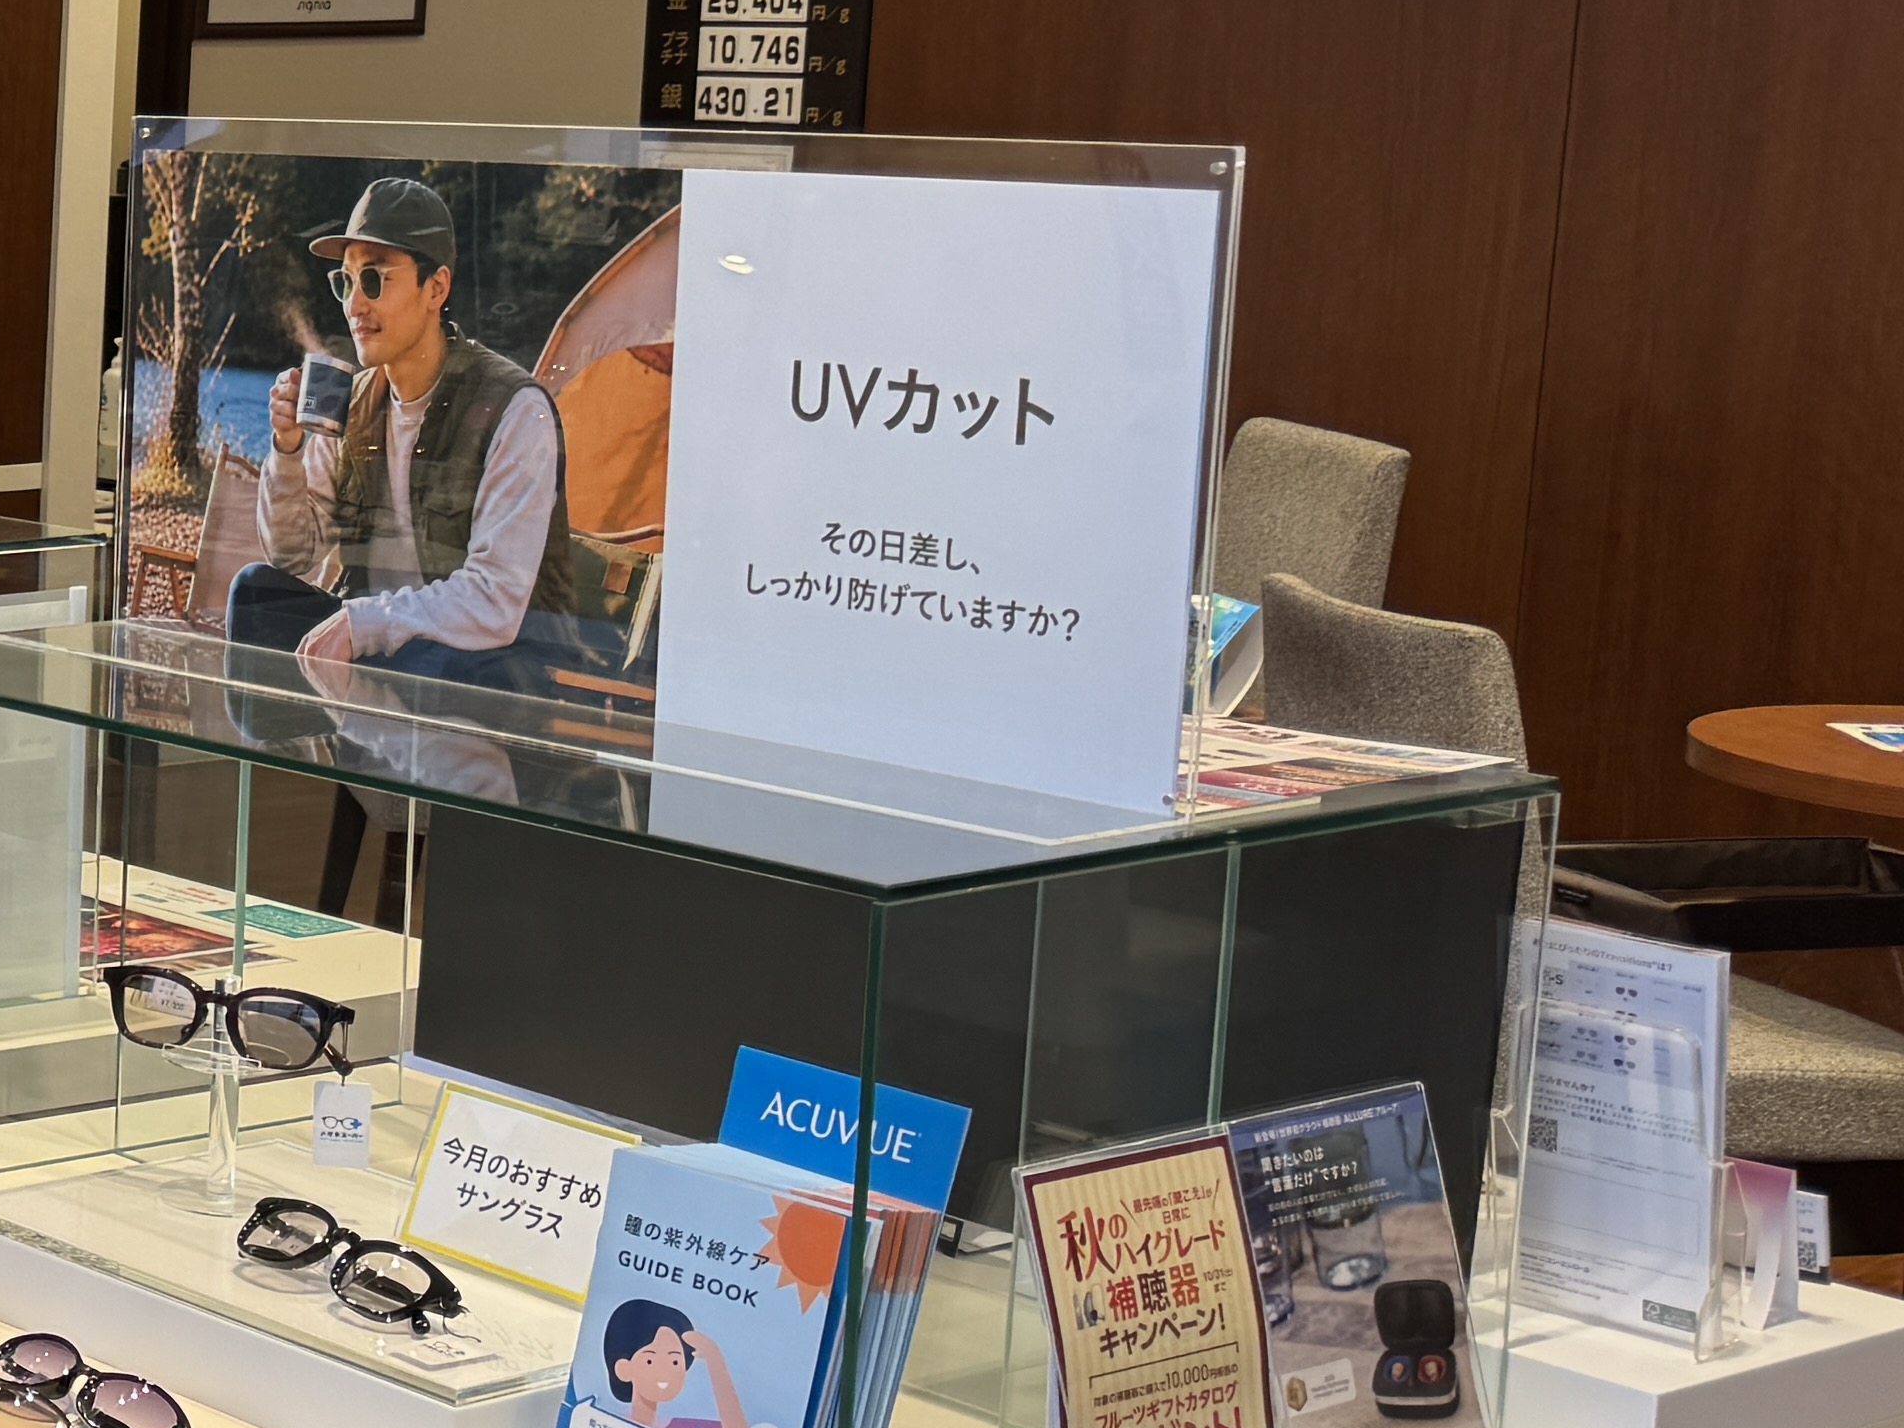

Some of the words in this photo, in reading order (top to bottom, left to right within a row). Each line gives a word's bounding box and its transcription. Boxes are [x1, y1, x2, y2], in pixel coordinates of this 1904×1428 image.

[296, 0, 332, 12] signia
[660, 83, 682, 109] 銀
[791, 359, 1056, 446] UVカット
[820, 522, 982, 575] その日差し、
[745, 563, 1082, 643] しっかり防げていますか?
[759, 1091, 918, 1164] ACUVUE
[442, 1136, 602, 1209] 今月のおすすめ
[456, 1181, 564, 1240] サングラス
[623, 1212, 771, 1273] 瞳の紫外線ケア
[1056, 1206, 1128, 1282] 秋の
[1115, 1219, 1226, 1271] ハイグレード
[618, 1249, 685, 1287] GUIDE
[691, 1274, 761, 1309] BOOK
[1106, 1262, 1201, 1322] 補聴器
[1099, 1302, 1226, 1359] キャンペーン!
